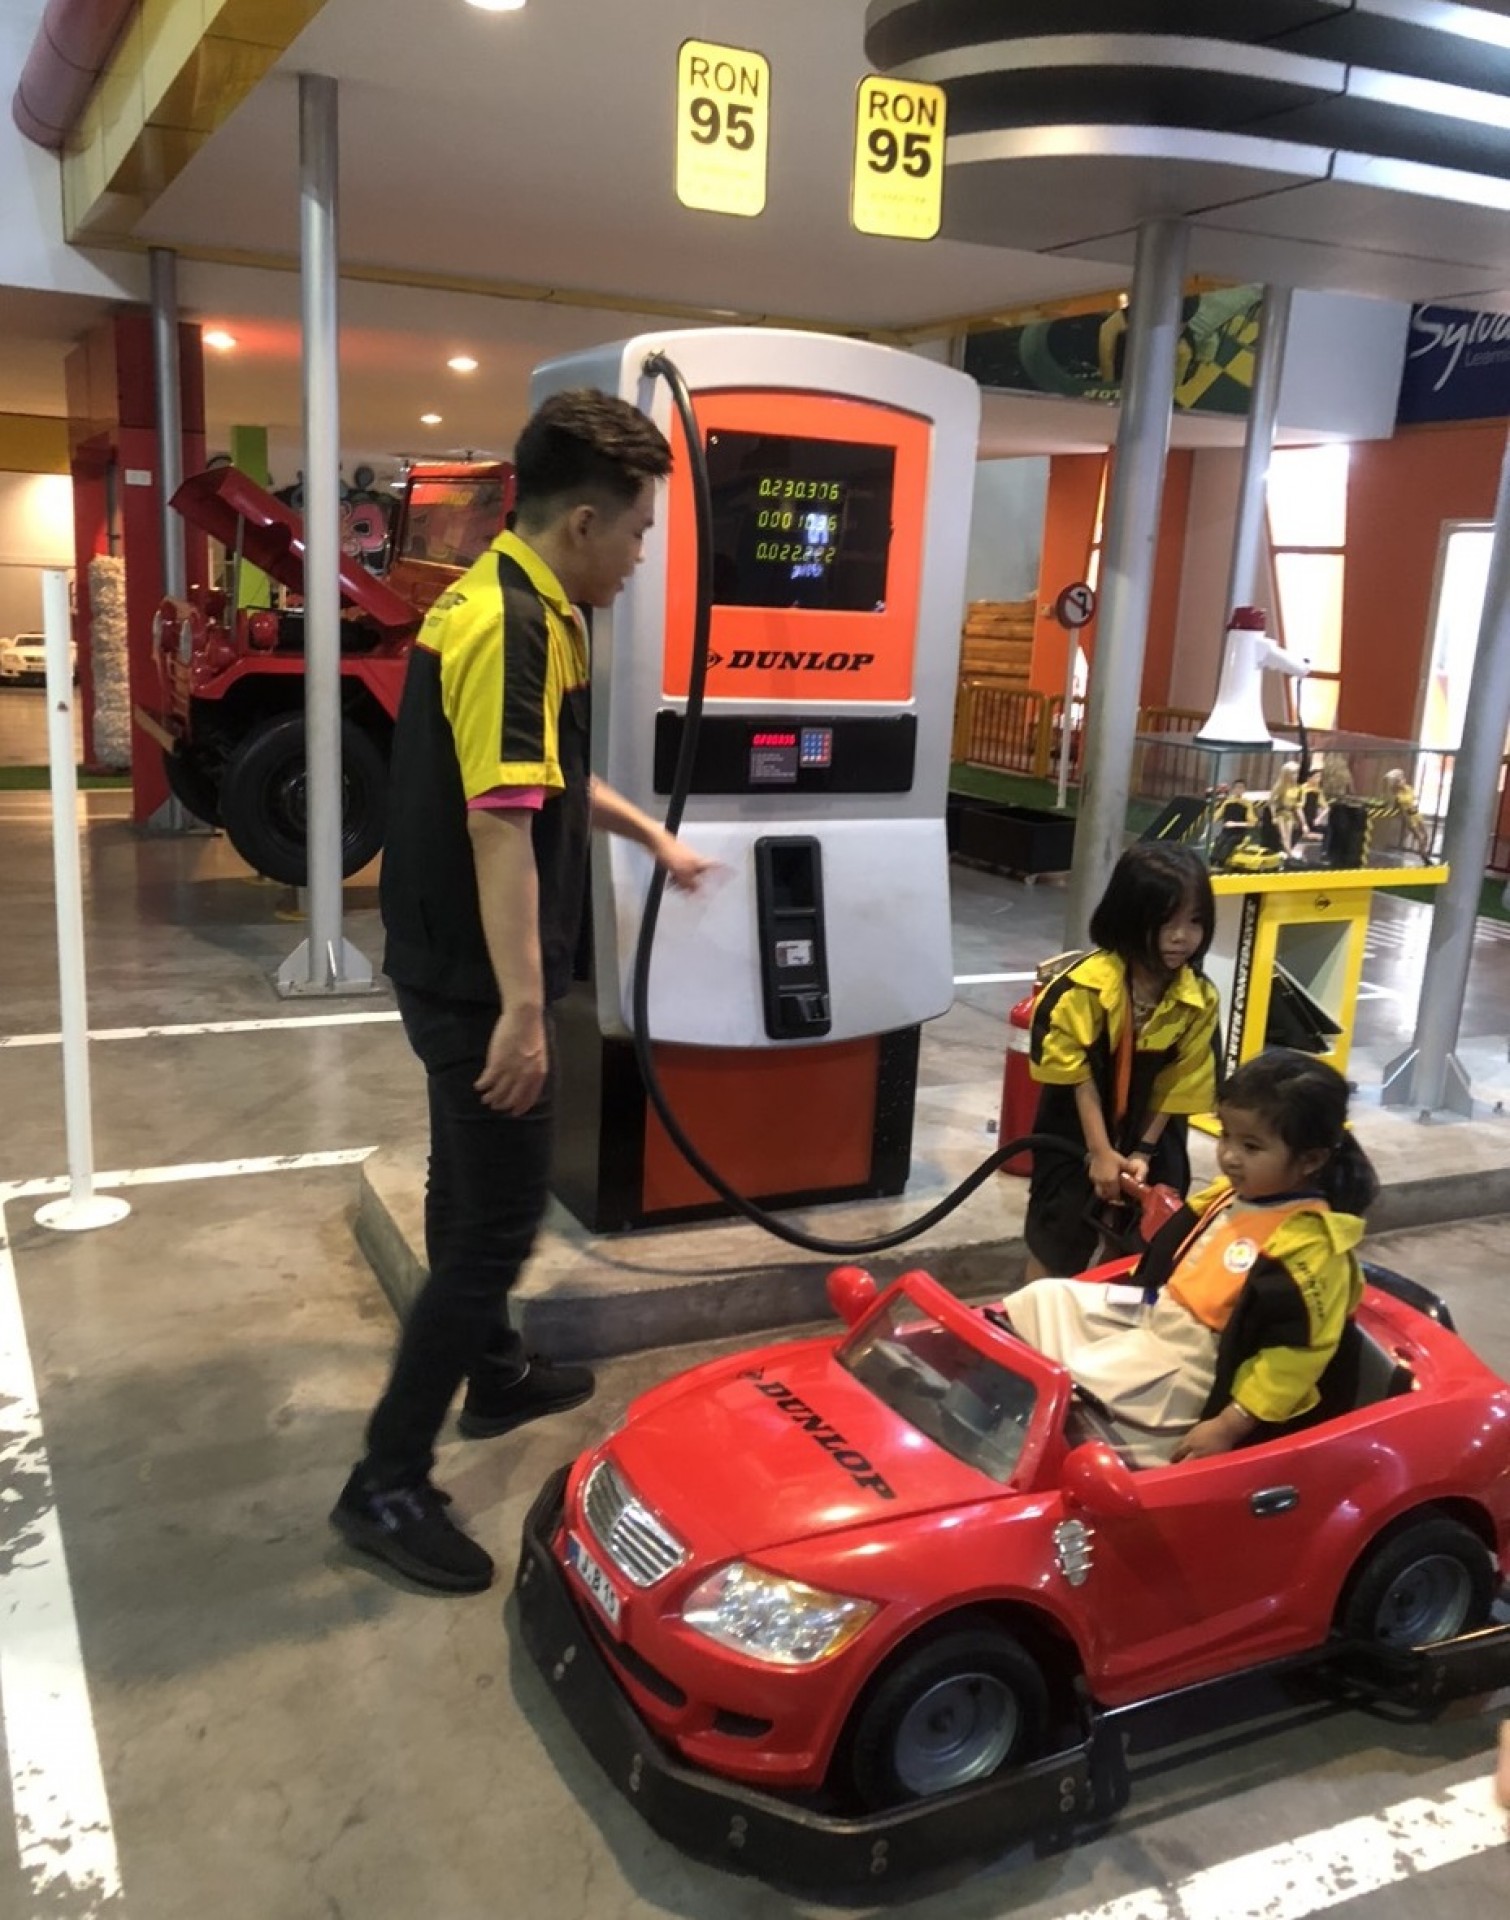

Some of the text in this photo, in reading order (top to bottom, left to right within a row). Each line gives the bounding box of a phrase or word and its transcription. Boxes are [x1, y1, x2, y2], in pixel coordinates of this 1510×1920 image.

[690, 56, 759, 98] RON
[690, 97, 755, 151] 95
[868, 90, 937, 127] RON
[867, 128, 931, 178] 95
[726, 650, 875, 671] DUNLOP
[754, 1381, 896, 1499] DUNLOP
